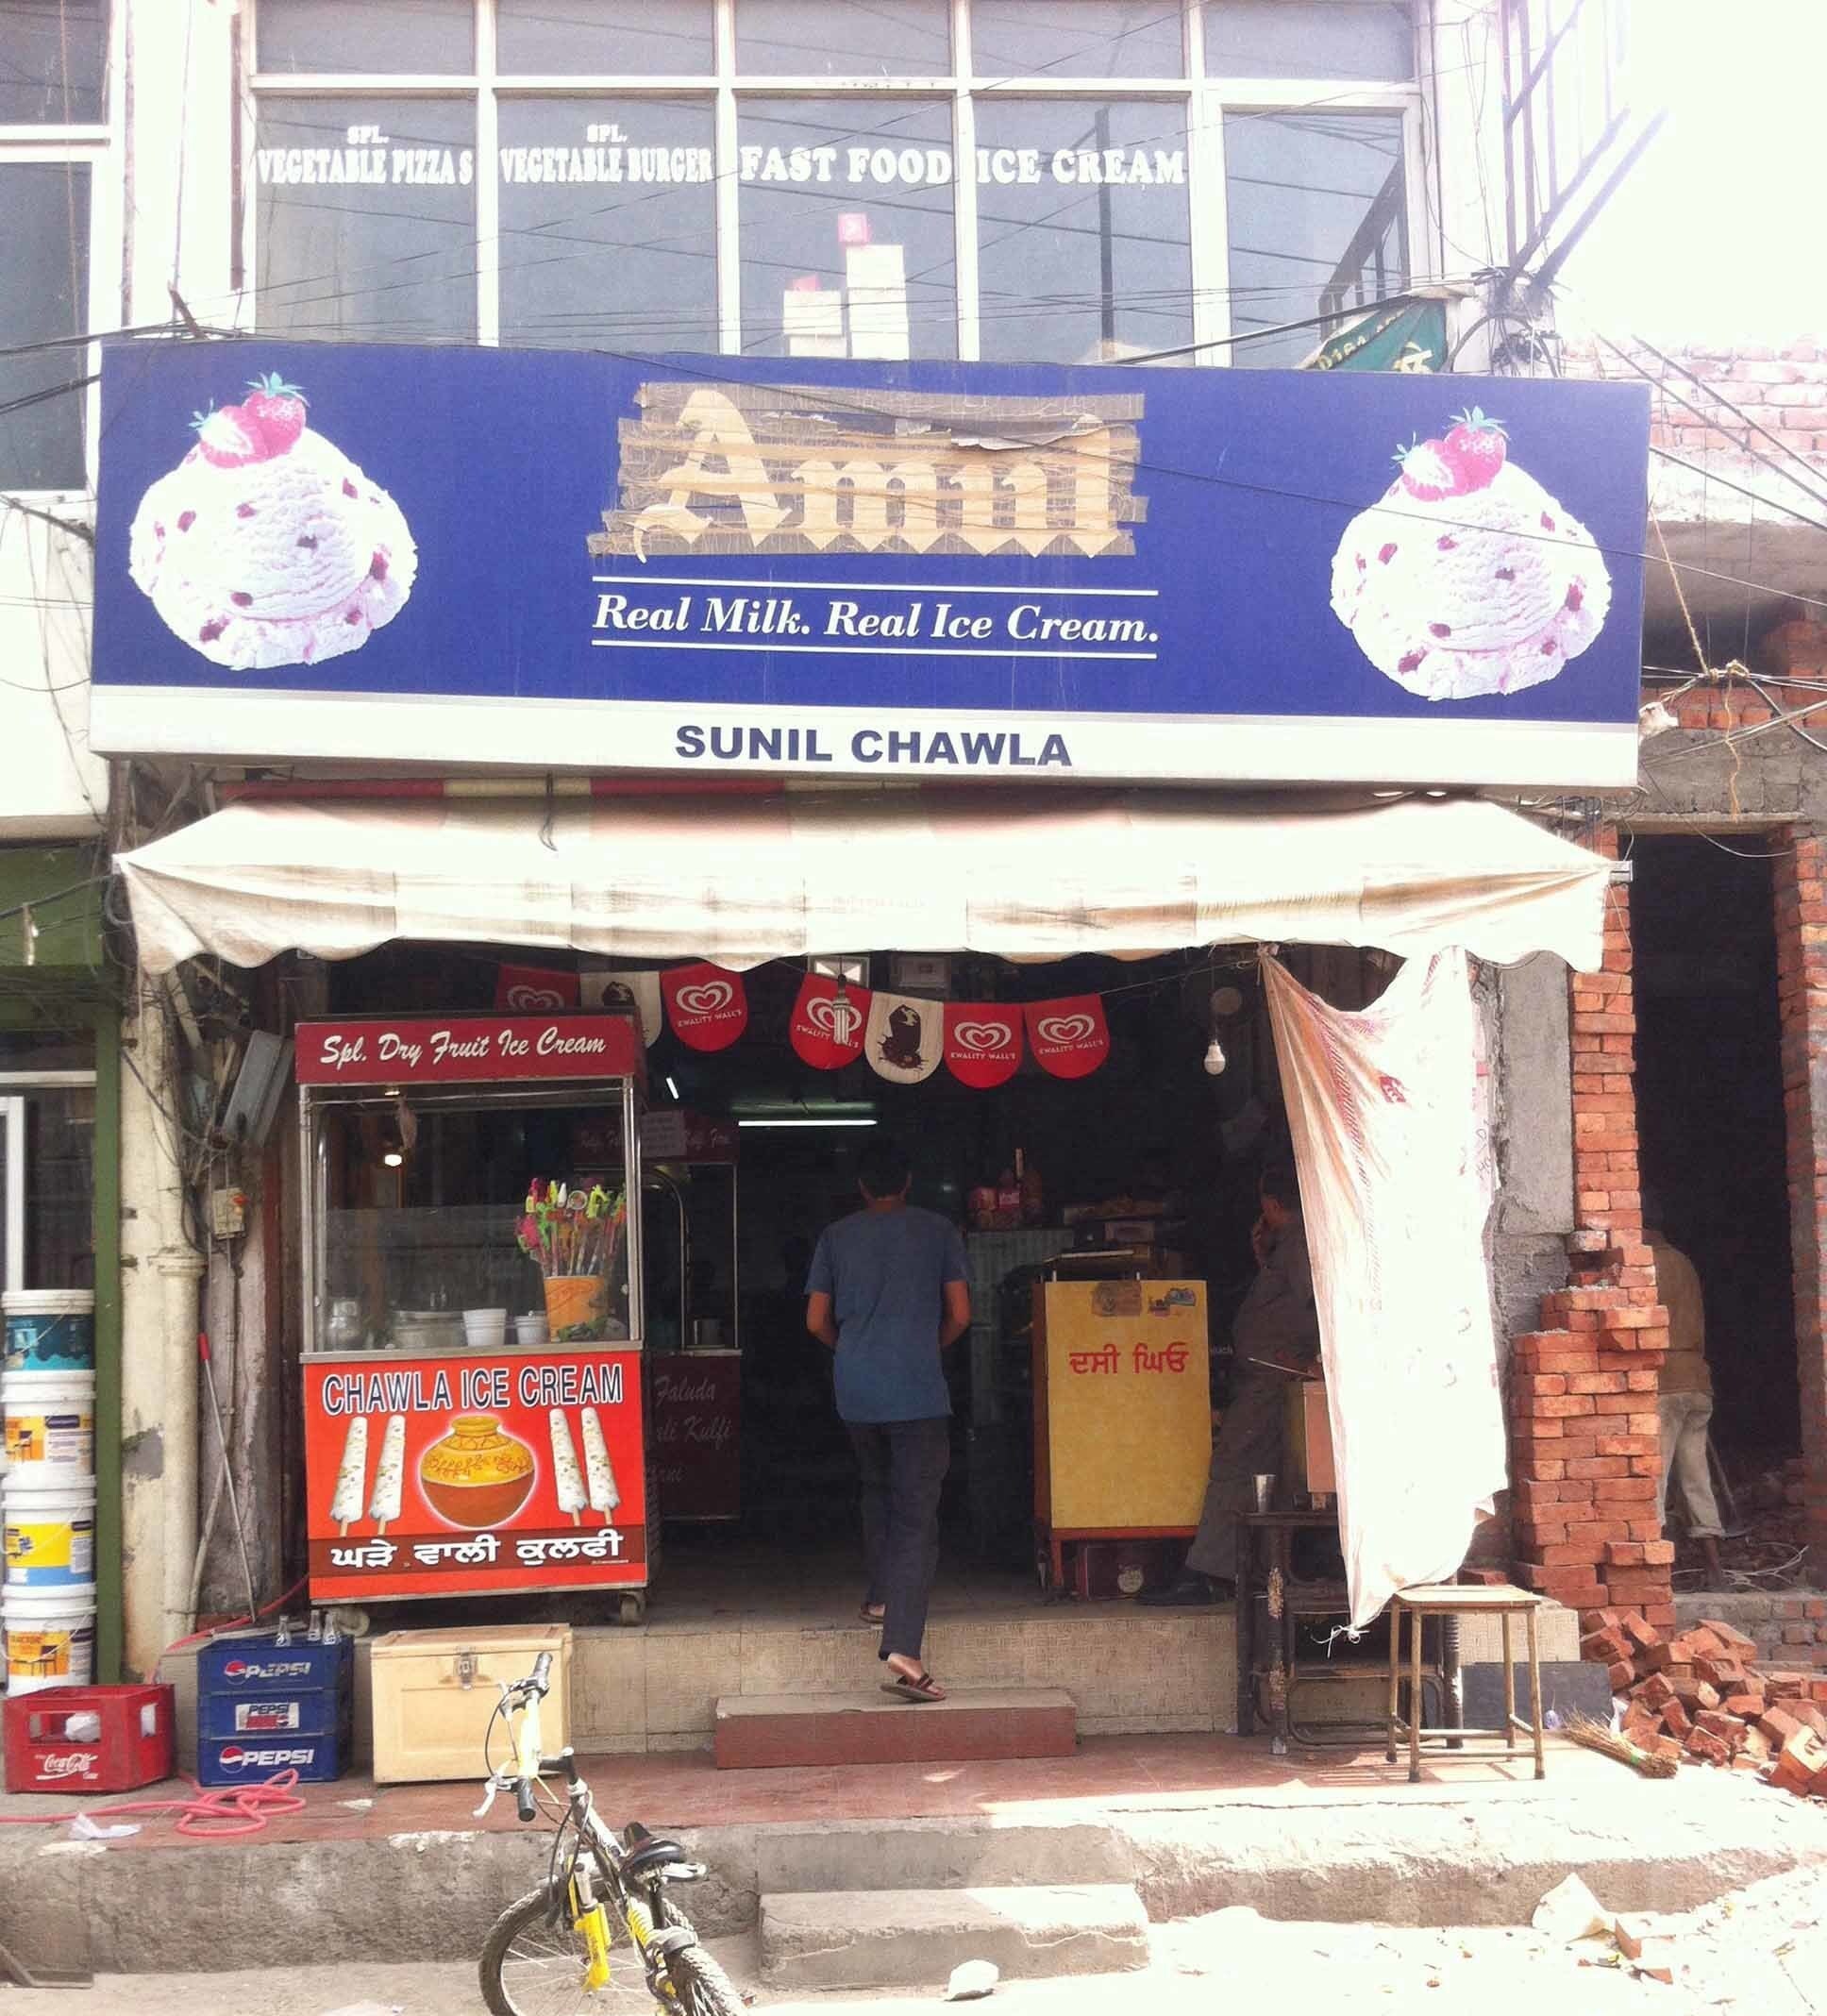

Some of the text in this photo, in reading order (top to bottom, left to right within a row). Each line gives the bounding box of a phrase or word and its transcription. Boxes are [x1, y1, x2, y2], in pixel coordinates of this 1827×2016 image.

[346, 124, 389, 144] SPL.
[586, 123, 628, 143] SPL.
[256, 148, 388, 185] VEGETABLE
[499, 146, 715, 183] VEGETABLE BURGER
[739, 146, 953, 184] FAST FOOD
[976, 148, 1186, 186] ICE CREAM
[634, 388, 1123, 560] Amul
[592, 594, 1160, 643] Real Milk. Real Ice Cream.
[675, 724, 1073, 767] SUNIL CHAWLA
[320, 1026, 607, 1070] Spl. Dry Fruit Ice Cream
[322, 1364, 624, 1416] CHAWLA ICE CREAM
[330, 1528, 624, 1569] ਘੜੇ ਵਾਲੀ ਕੁਲਫੀ
[245, 1661, 311, 1679] PEPSI
[247, 1704, 290, 1715] PEPSI
[241, 1748, 315, 1767] PEPSI
